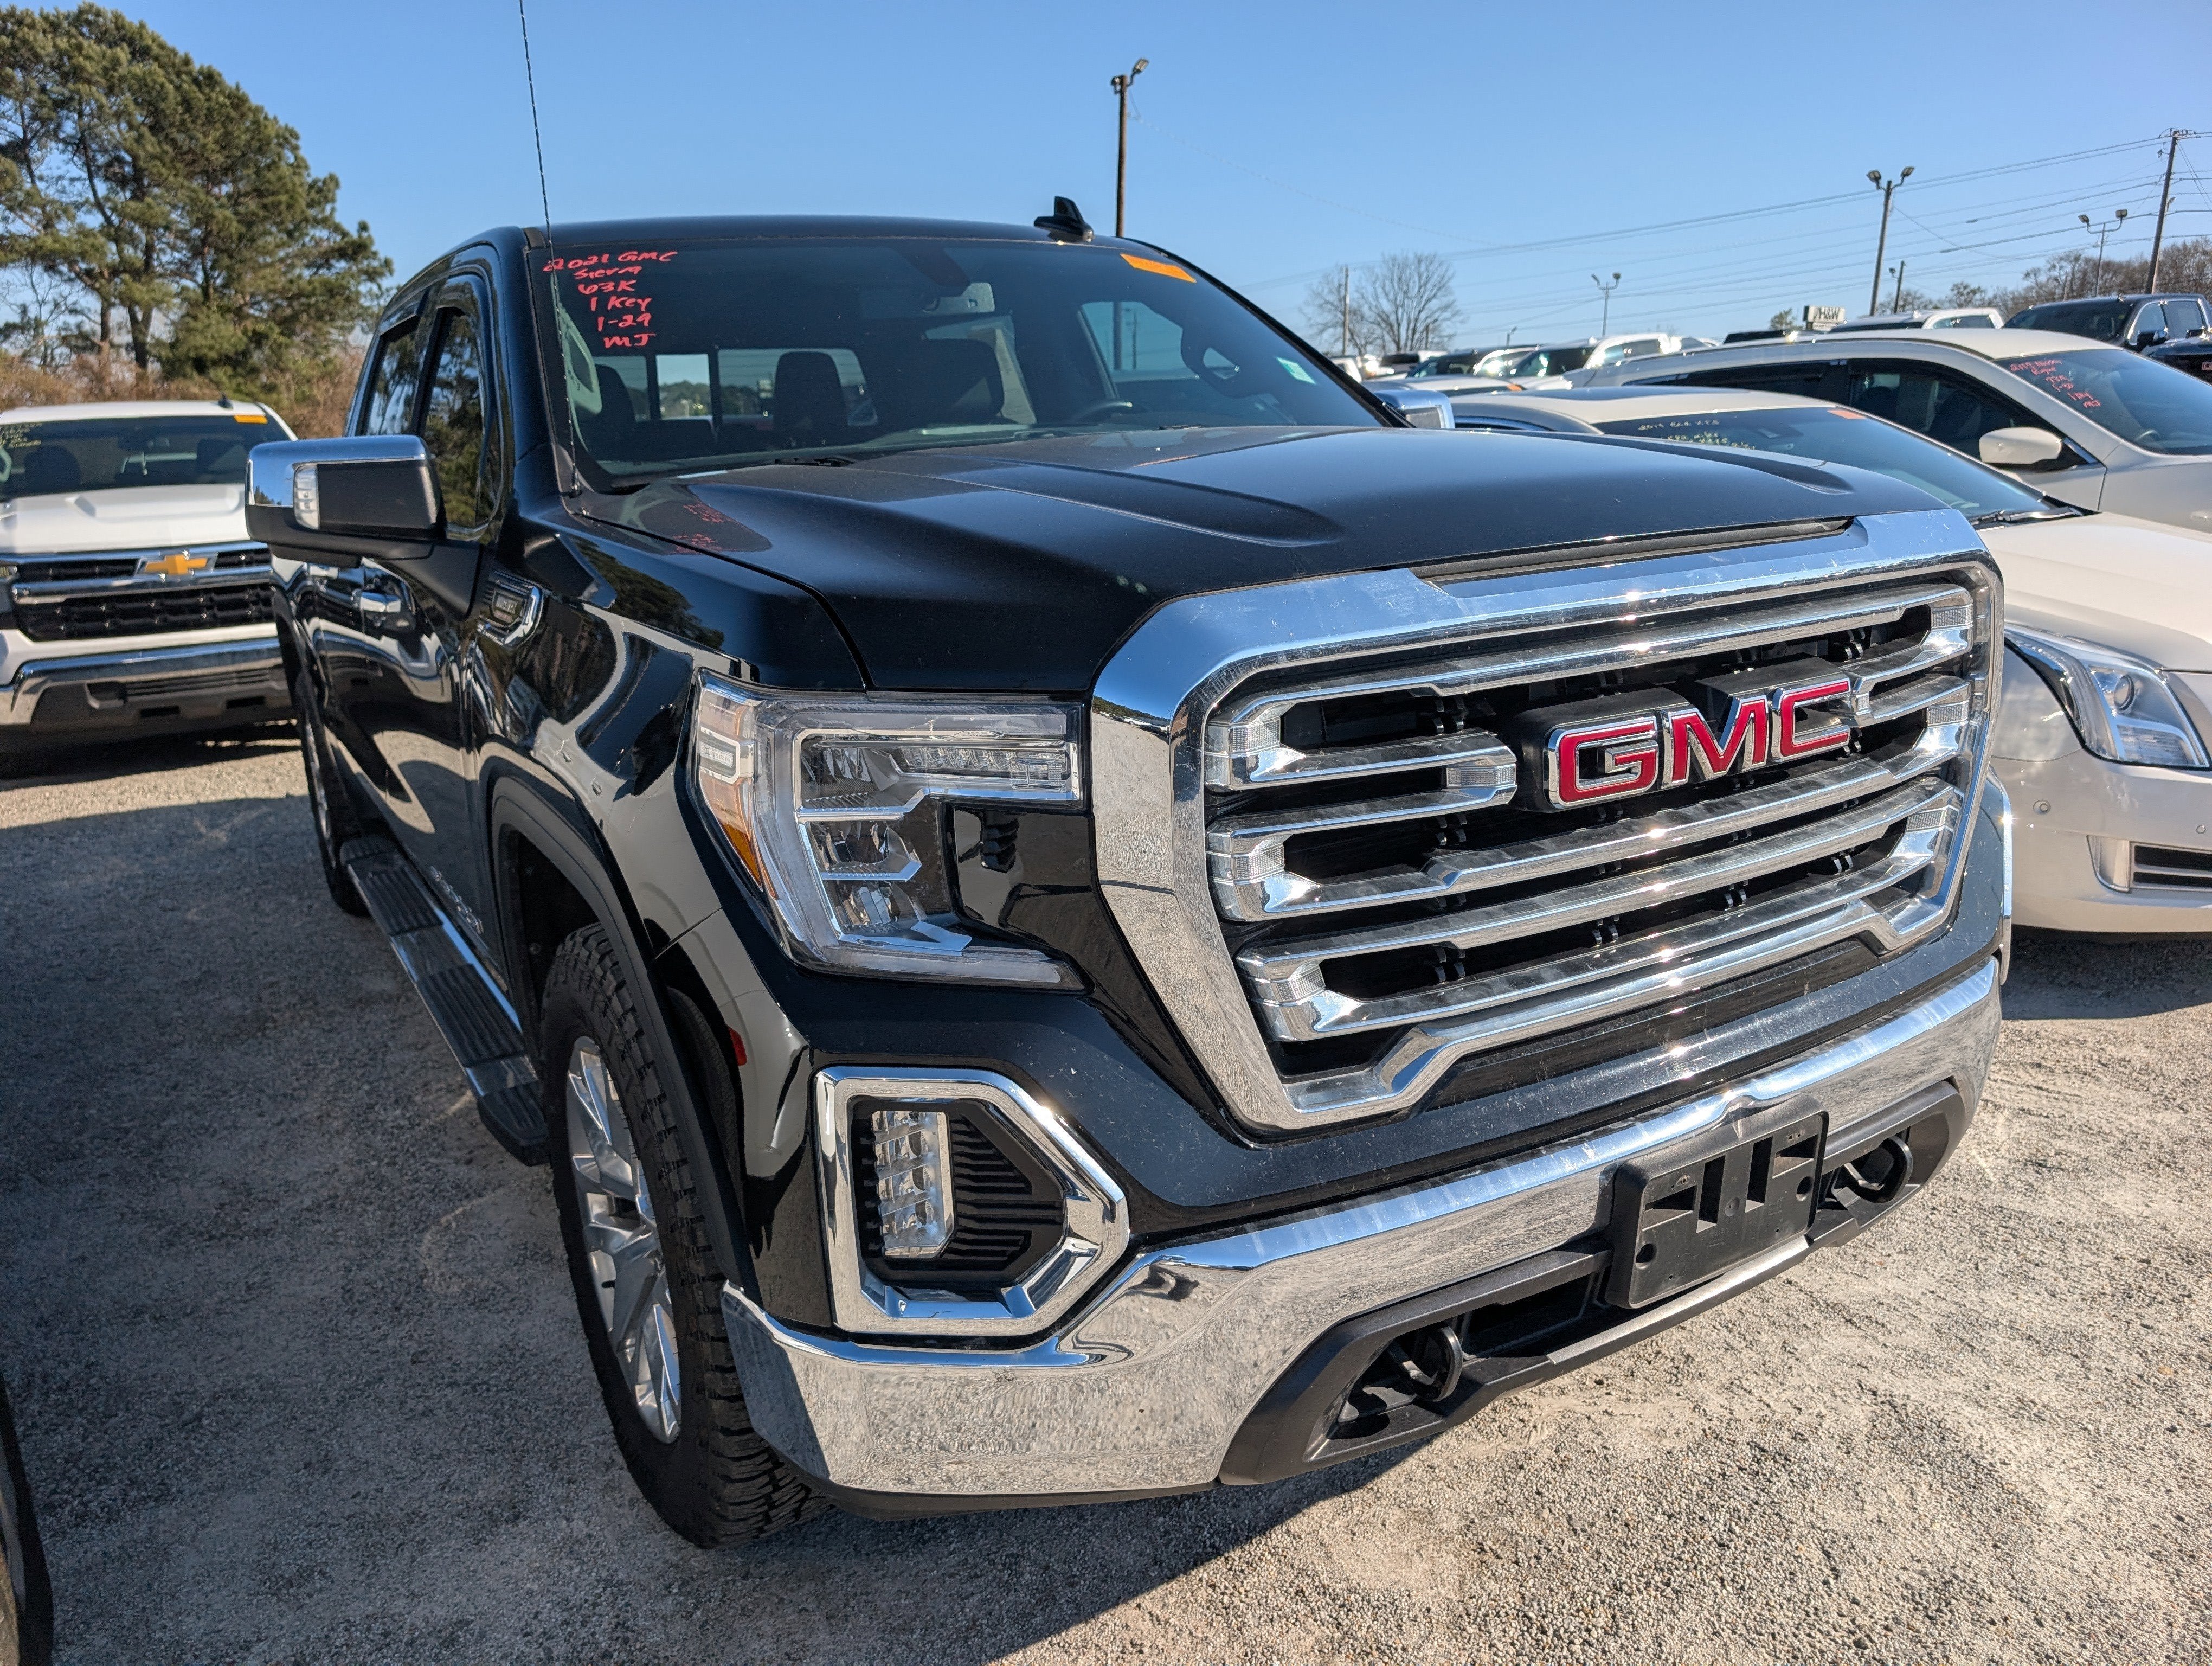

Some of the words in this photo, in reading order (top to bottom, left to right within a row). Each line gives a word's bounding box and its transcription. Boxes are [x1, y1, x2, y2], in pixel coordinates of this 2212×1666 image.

[618, 251, 677, 262] GMC
[578, 280, 636, 294] 63K
[590, 297, 598, 311] 1
[598, 313, 651, 331] 1-29
[1543, 678, 1851, 809] GMC
